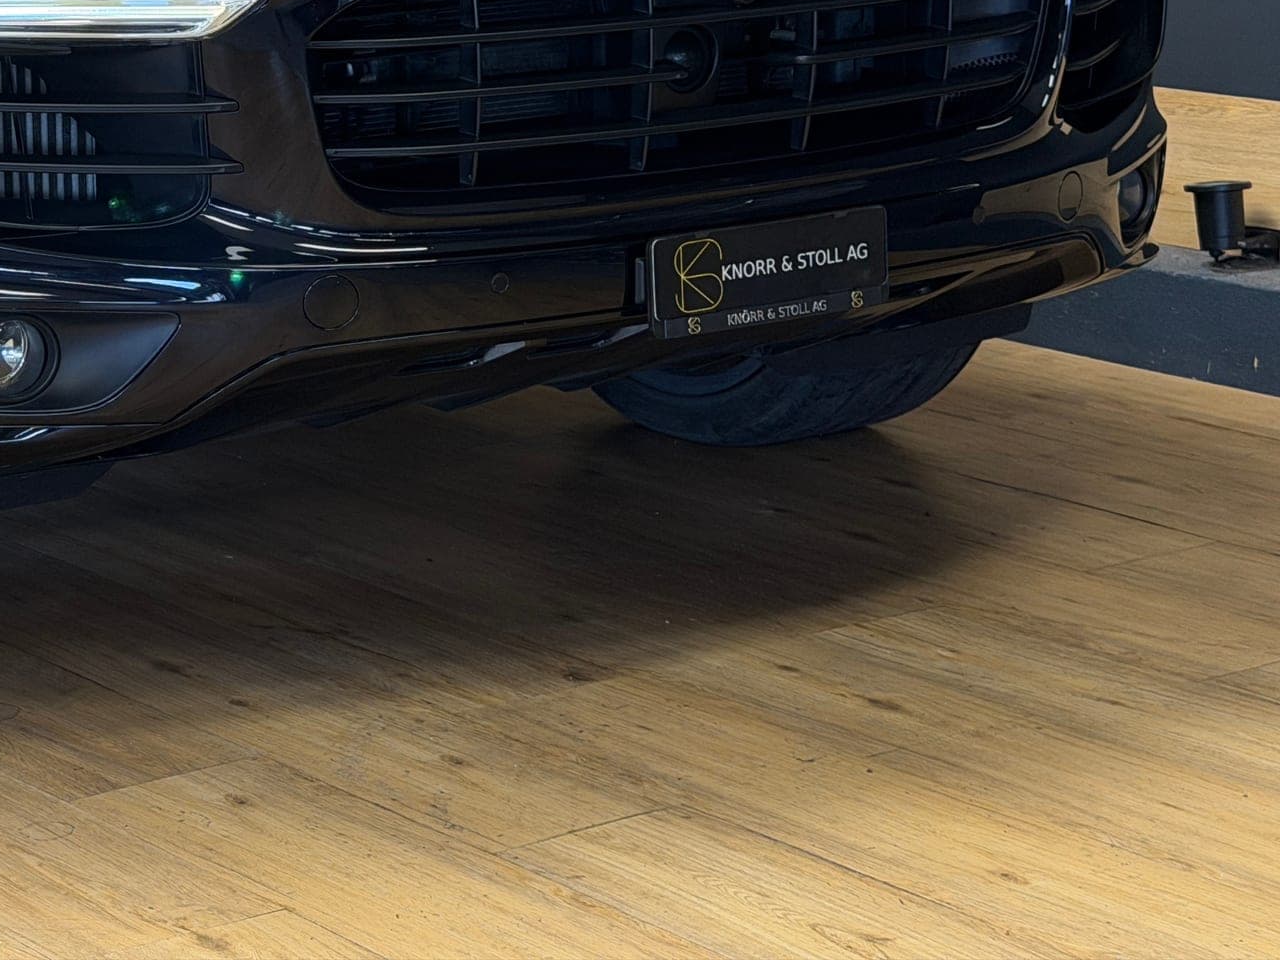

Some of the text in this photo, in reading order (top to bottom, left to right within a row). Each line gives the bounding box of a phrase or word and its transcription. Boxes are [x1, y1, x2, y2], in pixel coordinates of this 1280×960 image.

[721, 243, 869, 282] KNORR & STOLL AG
[767, 308, 776, 320] &
[779, 302, 811, 318] STOLL
[812, 300, 827, 312] AG
